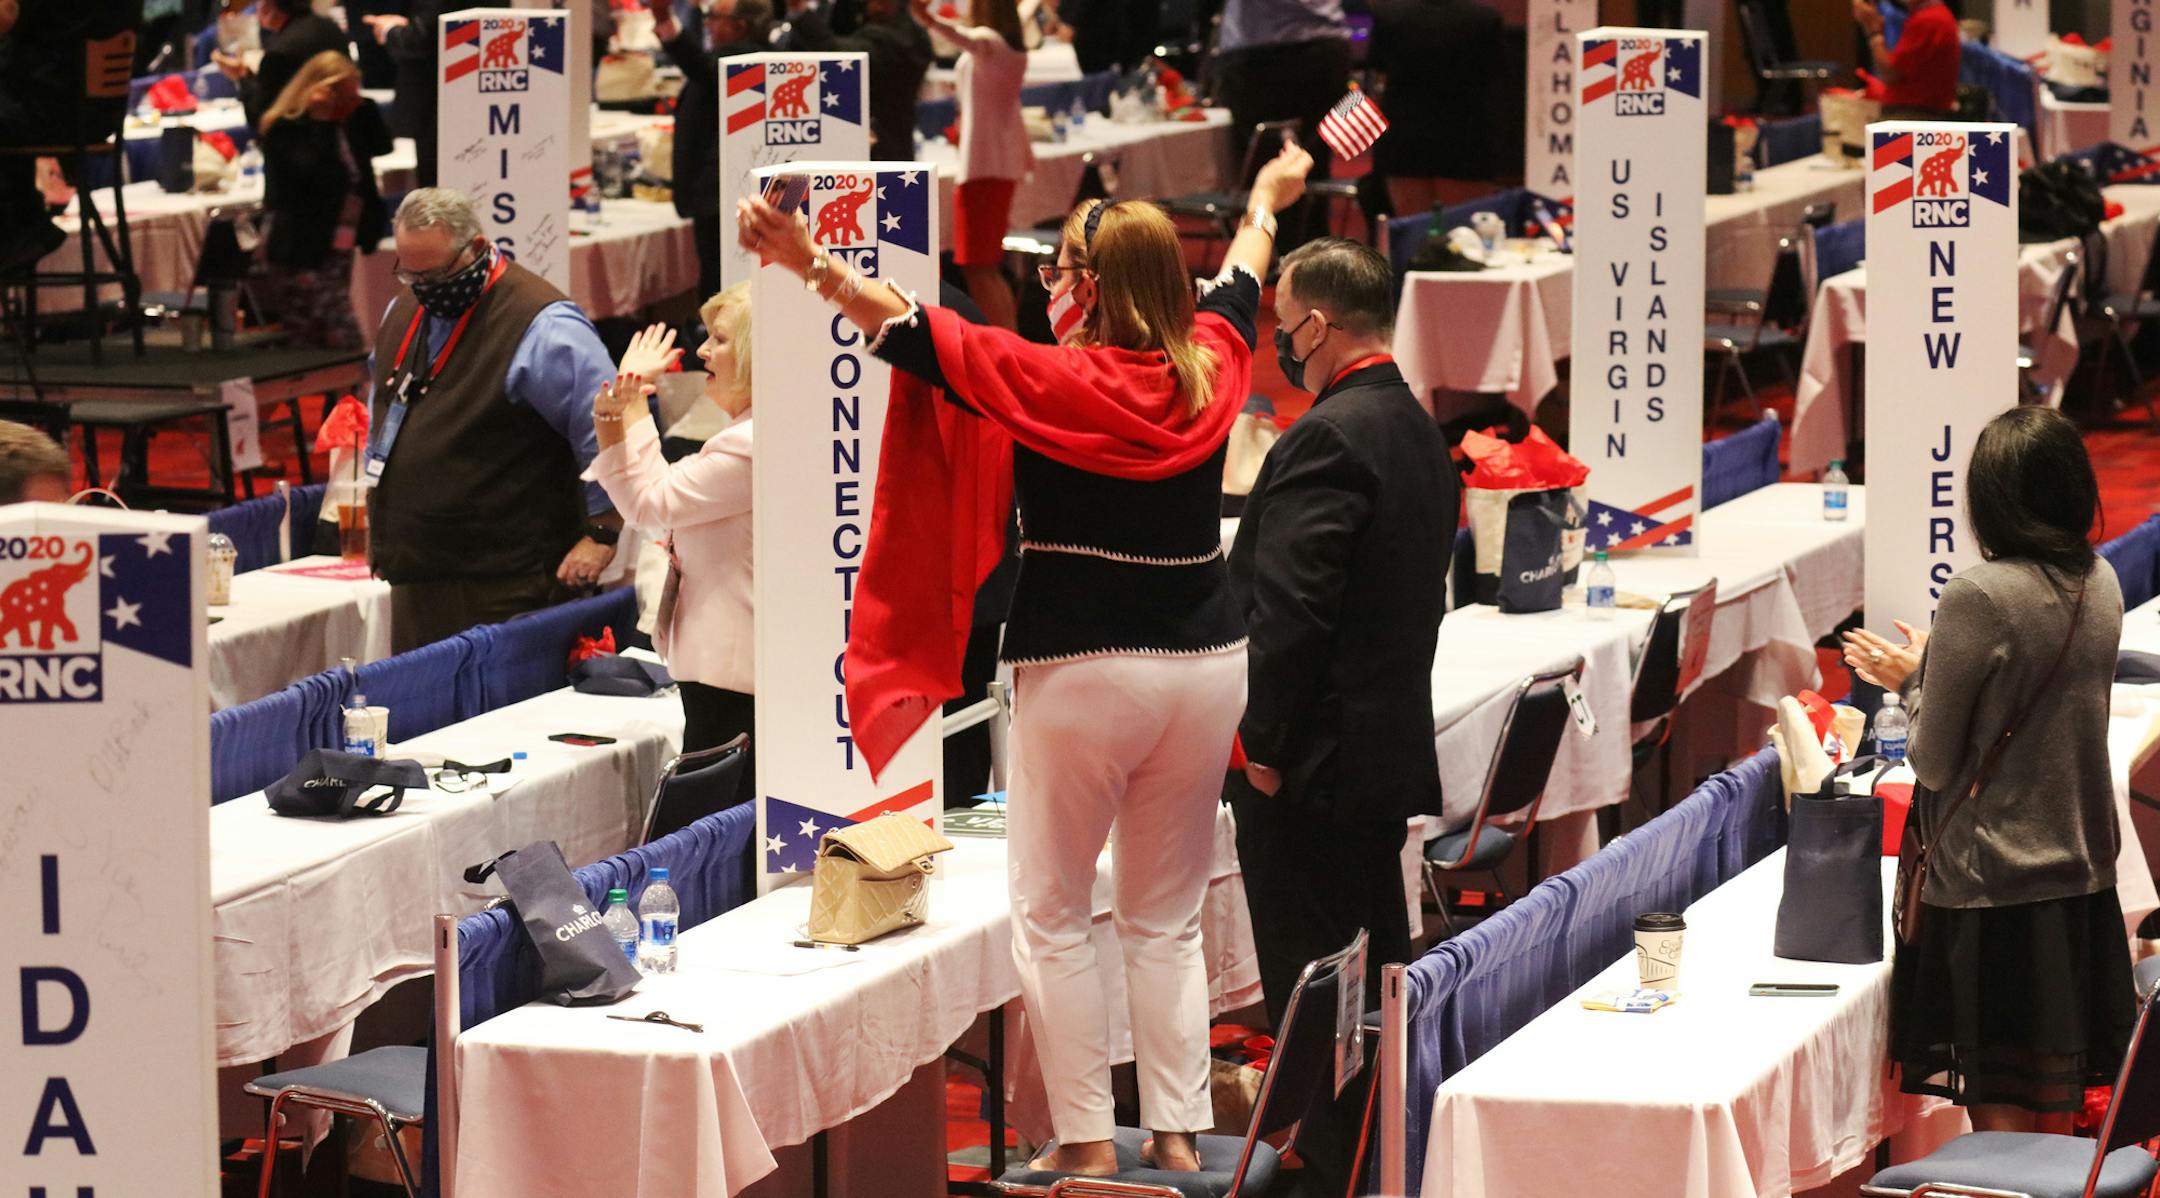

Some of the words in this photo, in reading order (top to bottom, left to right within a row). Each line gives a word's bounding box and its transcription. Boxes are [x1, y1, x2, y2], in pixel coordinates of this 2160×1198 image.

[483, 18, 514, 30] 2020
[1620, 39, 1651, 50] 2020
[481, 71, 526, 91] RNC
[769, 63, 803, 74] 2020
[2130, 0, 2152, 138] GINIA
[1549, 0, 1573, 184] LAHOMA
[1617, 95, 1663, 114] RNC
[767, 121, 820, 144] RNC
[1916, 133, 1952, 146] 2020
[813, 175, 857, 190] 2020
[1611, 160, 1630, 218] US
[1914, 202, 1967, 226] RNC
[826, 249, 876, 276] NC
[1647, 192, 1667, 422] ISLANDS
[1924, 241, 1961, 368] NEW
[1607, 262, 1628, 458] VIRGIN
[1930, 425, 1954, 624] JERS
[555, 911, 602, 941] CHARLO
[20, 854, 97, 1198] IDA
